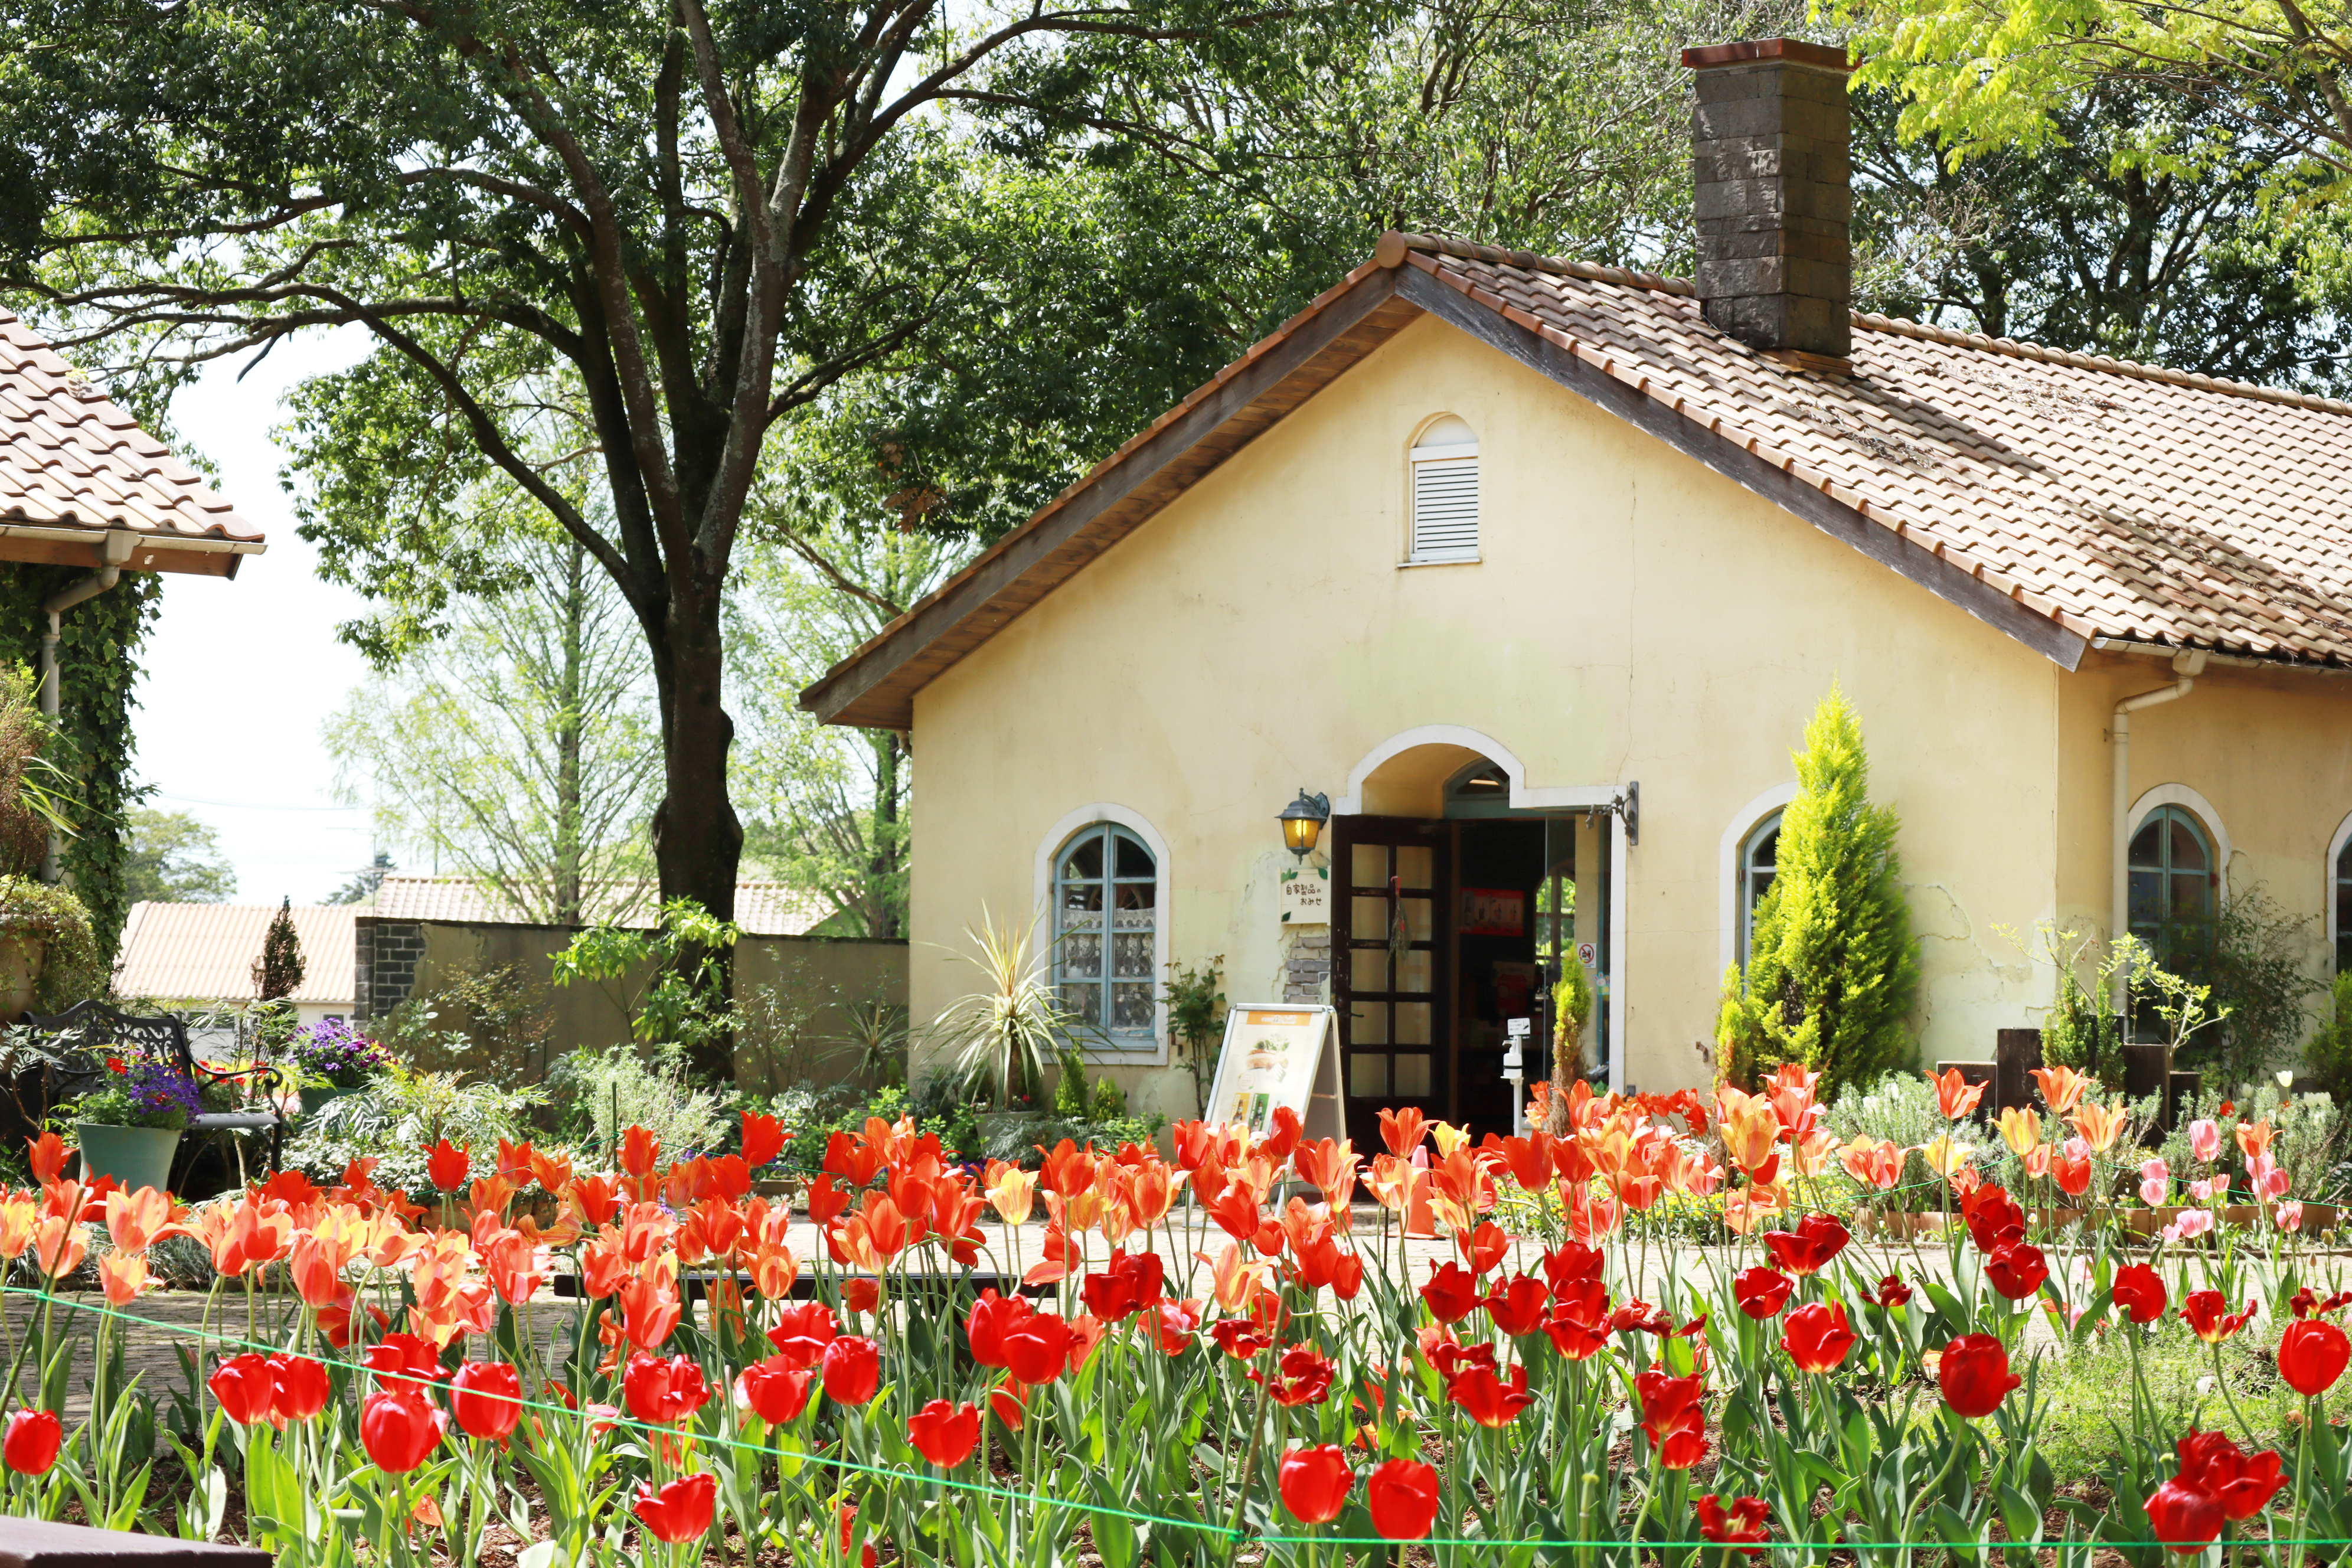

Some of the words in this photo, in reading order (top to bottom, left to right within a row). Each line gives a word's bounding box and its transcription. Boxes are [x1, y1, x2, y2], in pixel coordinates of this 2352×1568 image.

[1286, 883, 1321, 895] 自家製品の
